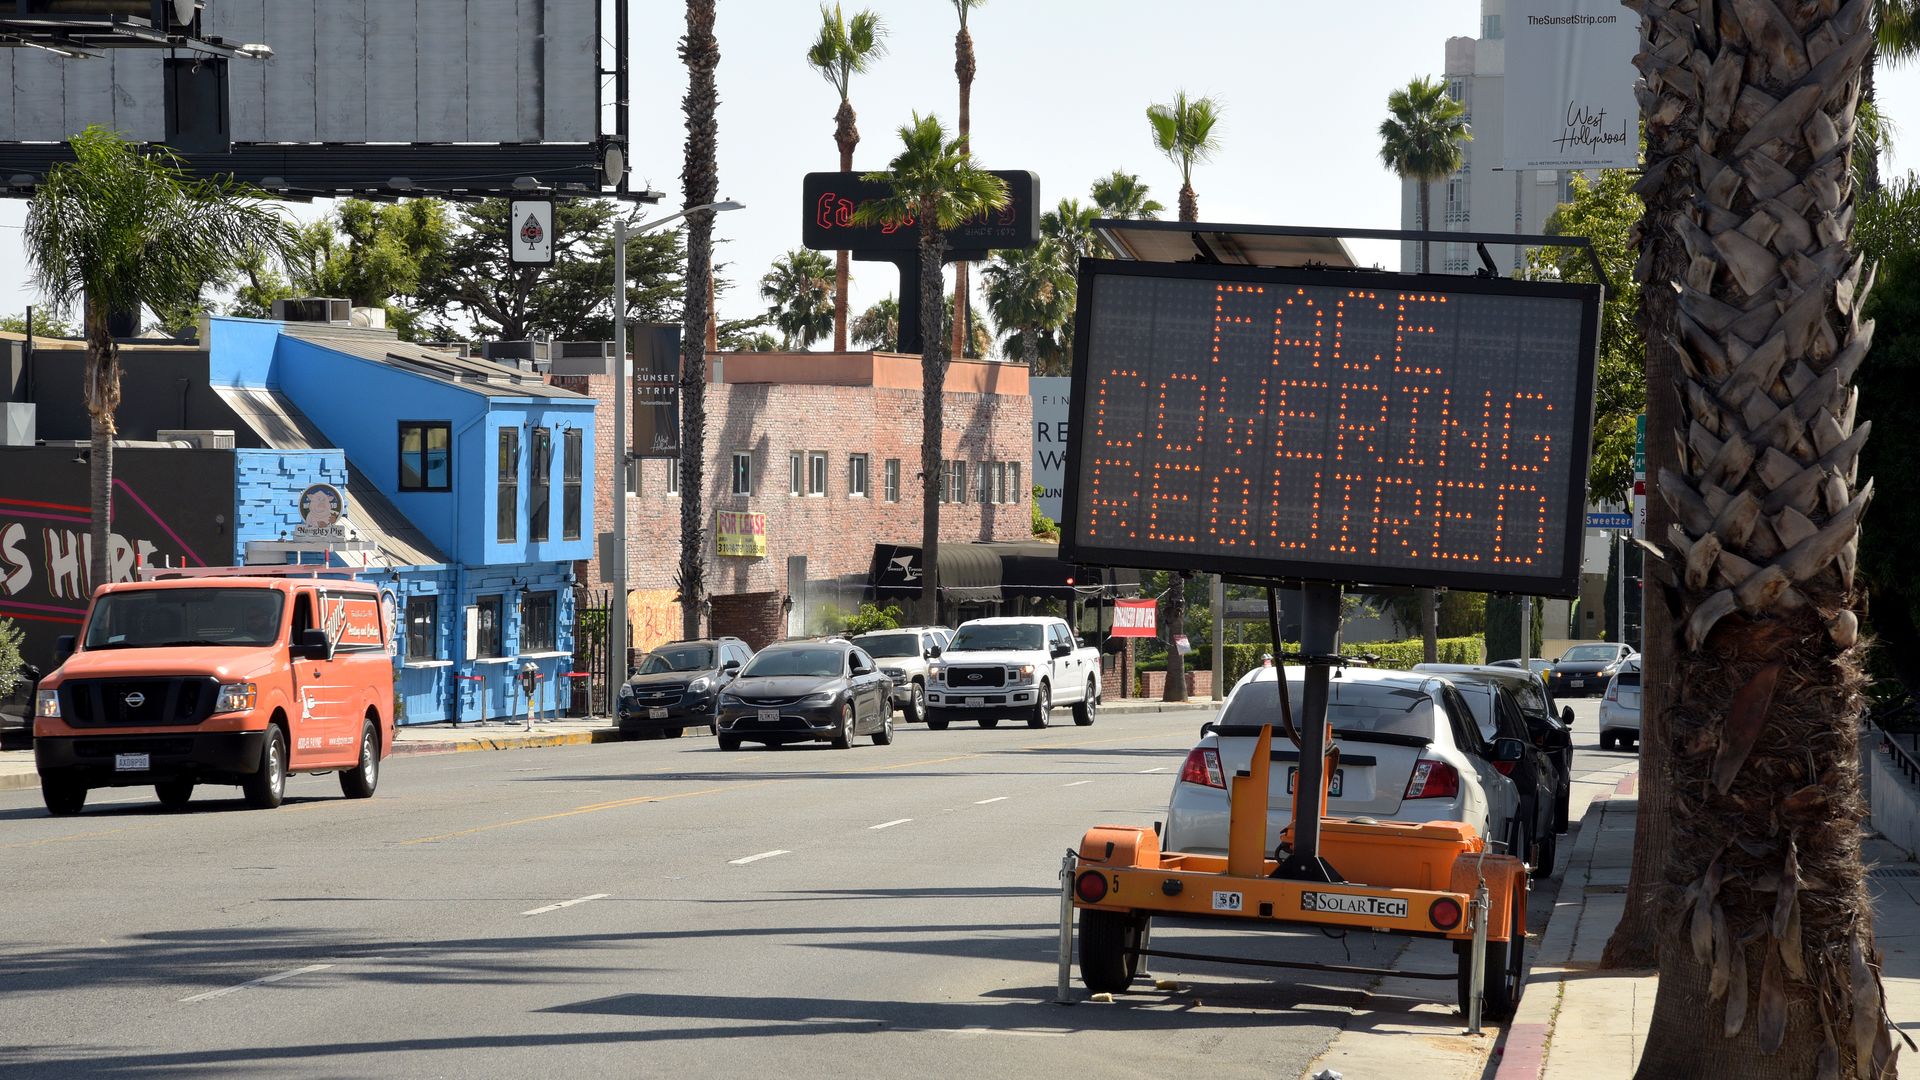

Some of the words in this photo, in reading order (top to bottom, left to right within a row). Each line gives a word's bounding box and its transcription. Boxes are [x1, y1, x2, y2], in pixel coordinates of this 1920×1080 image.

[1527, 14, 1617, 26] TheSunsetStrip.com
[1566, 100, 1607, 133] West
[1552, 119, 1627, 155] Hollywood
[1212, 284, 1448, 375] FACE
[637, 374, 676, 382] SUNSET
[637, 387, 675, 395] STRIP
[1097, 370, 1553, 473] COVERING
[1090, 458, 1546, 565] REQUIRED
[1586, 516, 1630, 525] Sweetzer
[298, 527, 328, 536] Naughty
[330, 526, 343, 536] Pig
[719, 513, 736, 534] FOR
[740, 513, 765, 535] LEASE
[1112, 875, 1119, 893] 5
